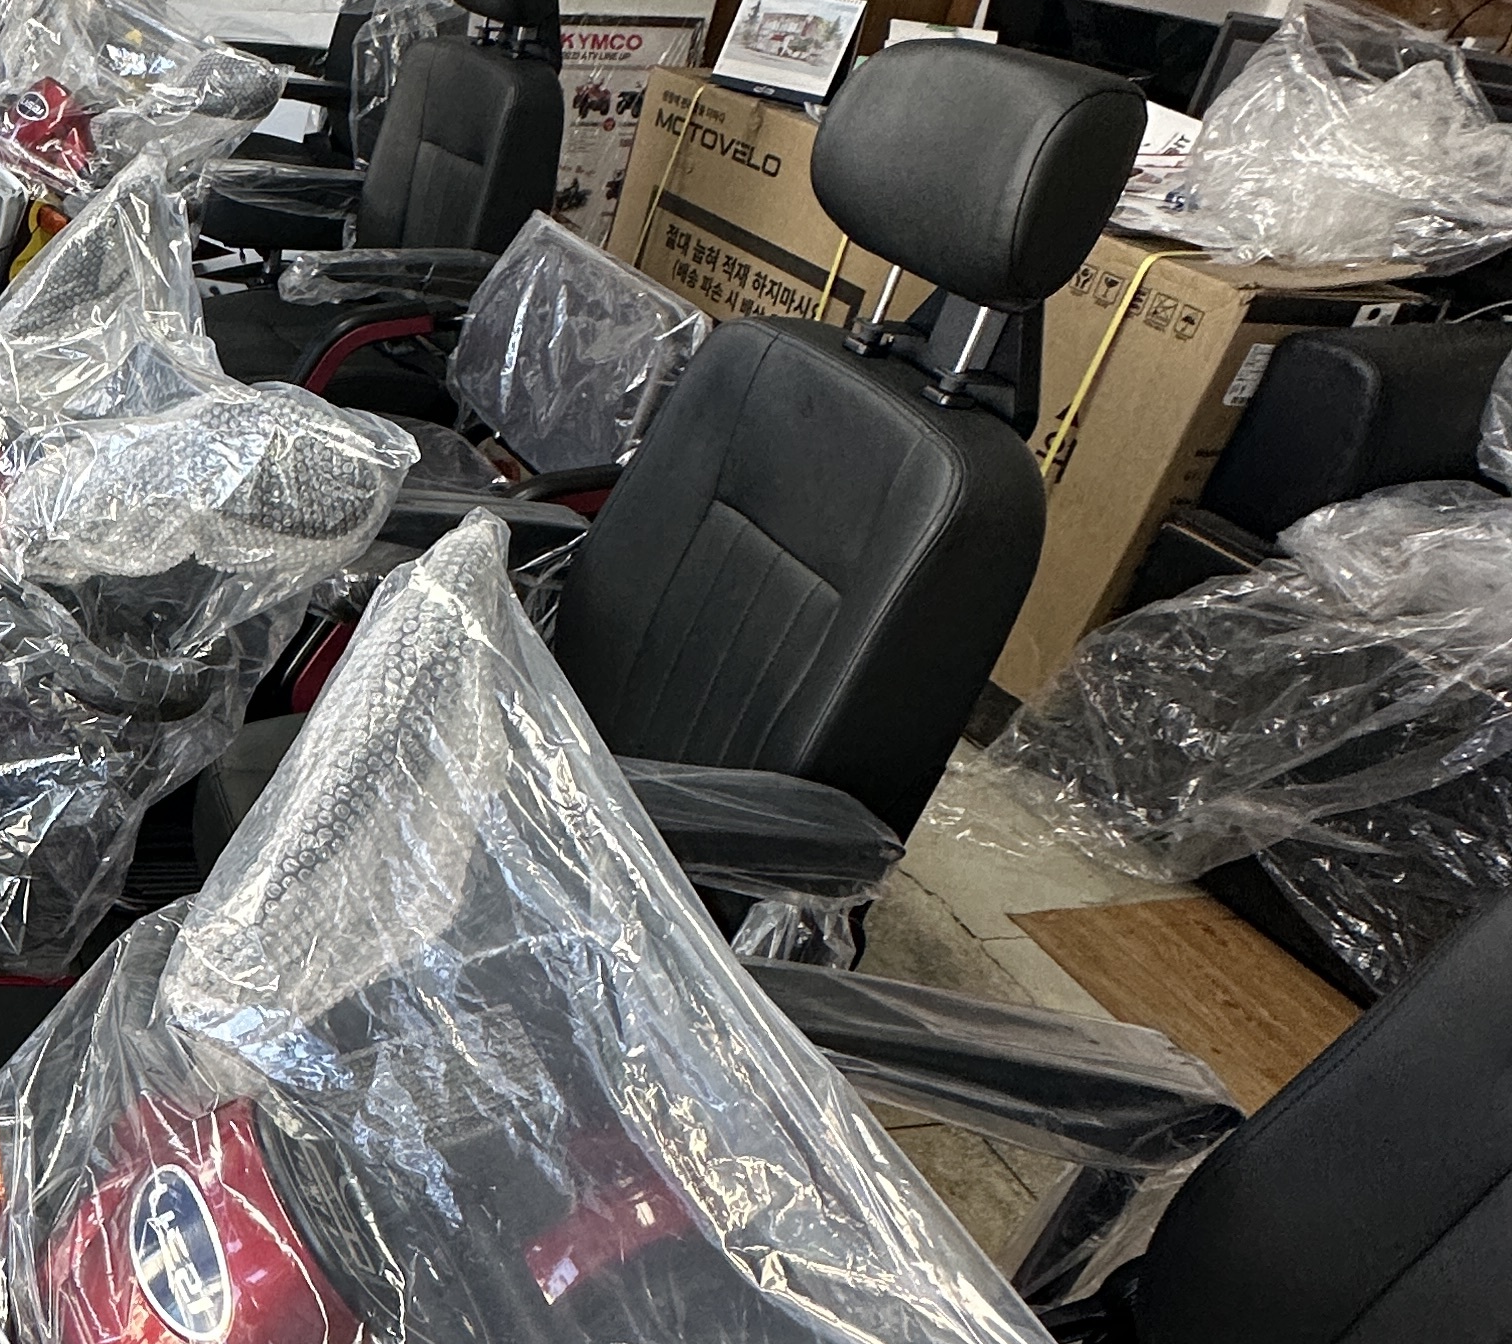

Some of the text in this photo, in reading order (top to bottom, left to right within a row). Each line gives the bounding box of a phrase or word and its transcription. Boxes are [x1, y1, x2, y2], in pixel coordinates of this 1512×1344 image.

[561, 33, 643, 51] KYMCO
[654, 107, 782, 178] MOTOVELO
[666, 223, 692, 256] 절대
[692, 238, 721, 272] 눕혀
[722, 254, 752, 289] 적재
[725, 290, 740, 312] 시
